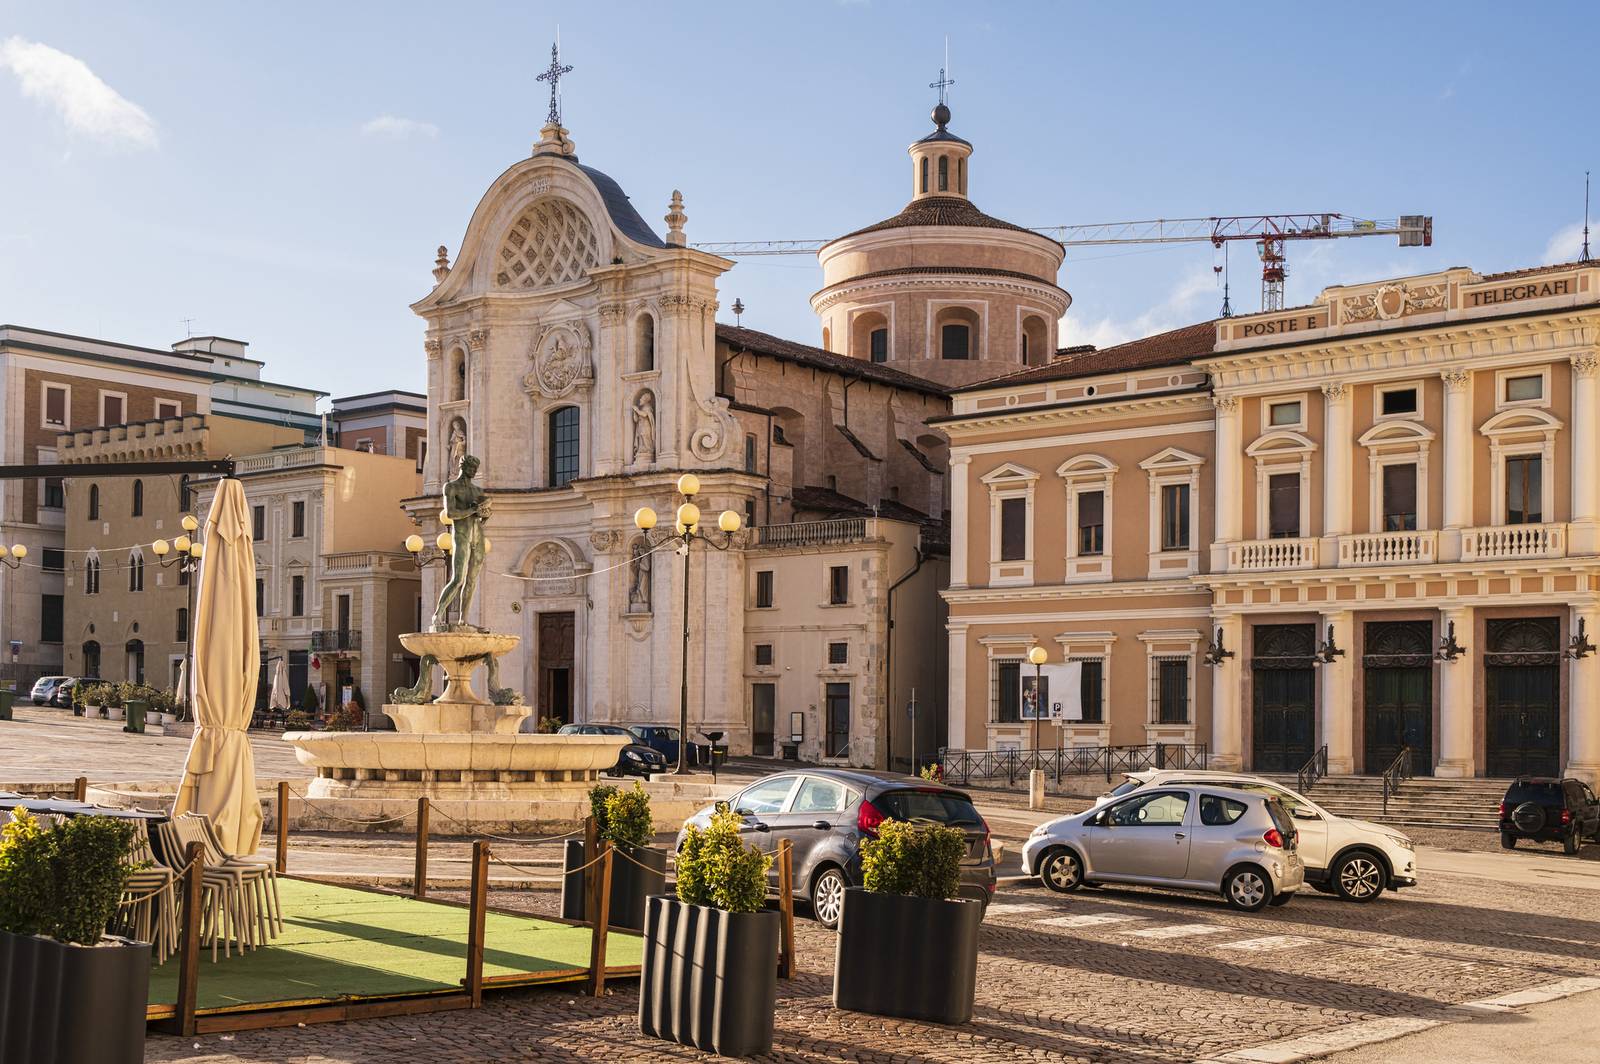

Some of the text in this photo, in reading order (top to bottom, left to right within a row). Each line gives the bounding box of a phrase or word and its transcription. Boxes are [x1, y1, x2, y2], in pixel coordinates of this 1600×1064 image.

[1470, 280, 1569, 306] TELEGRAFI
[1244, 316, 1317, 337] POSTE E
